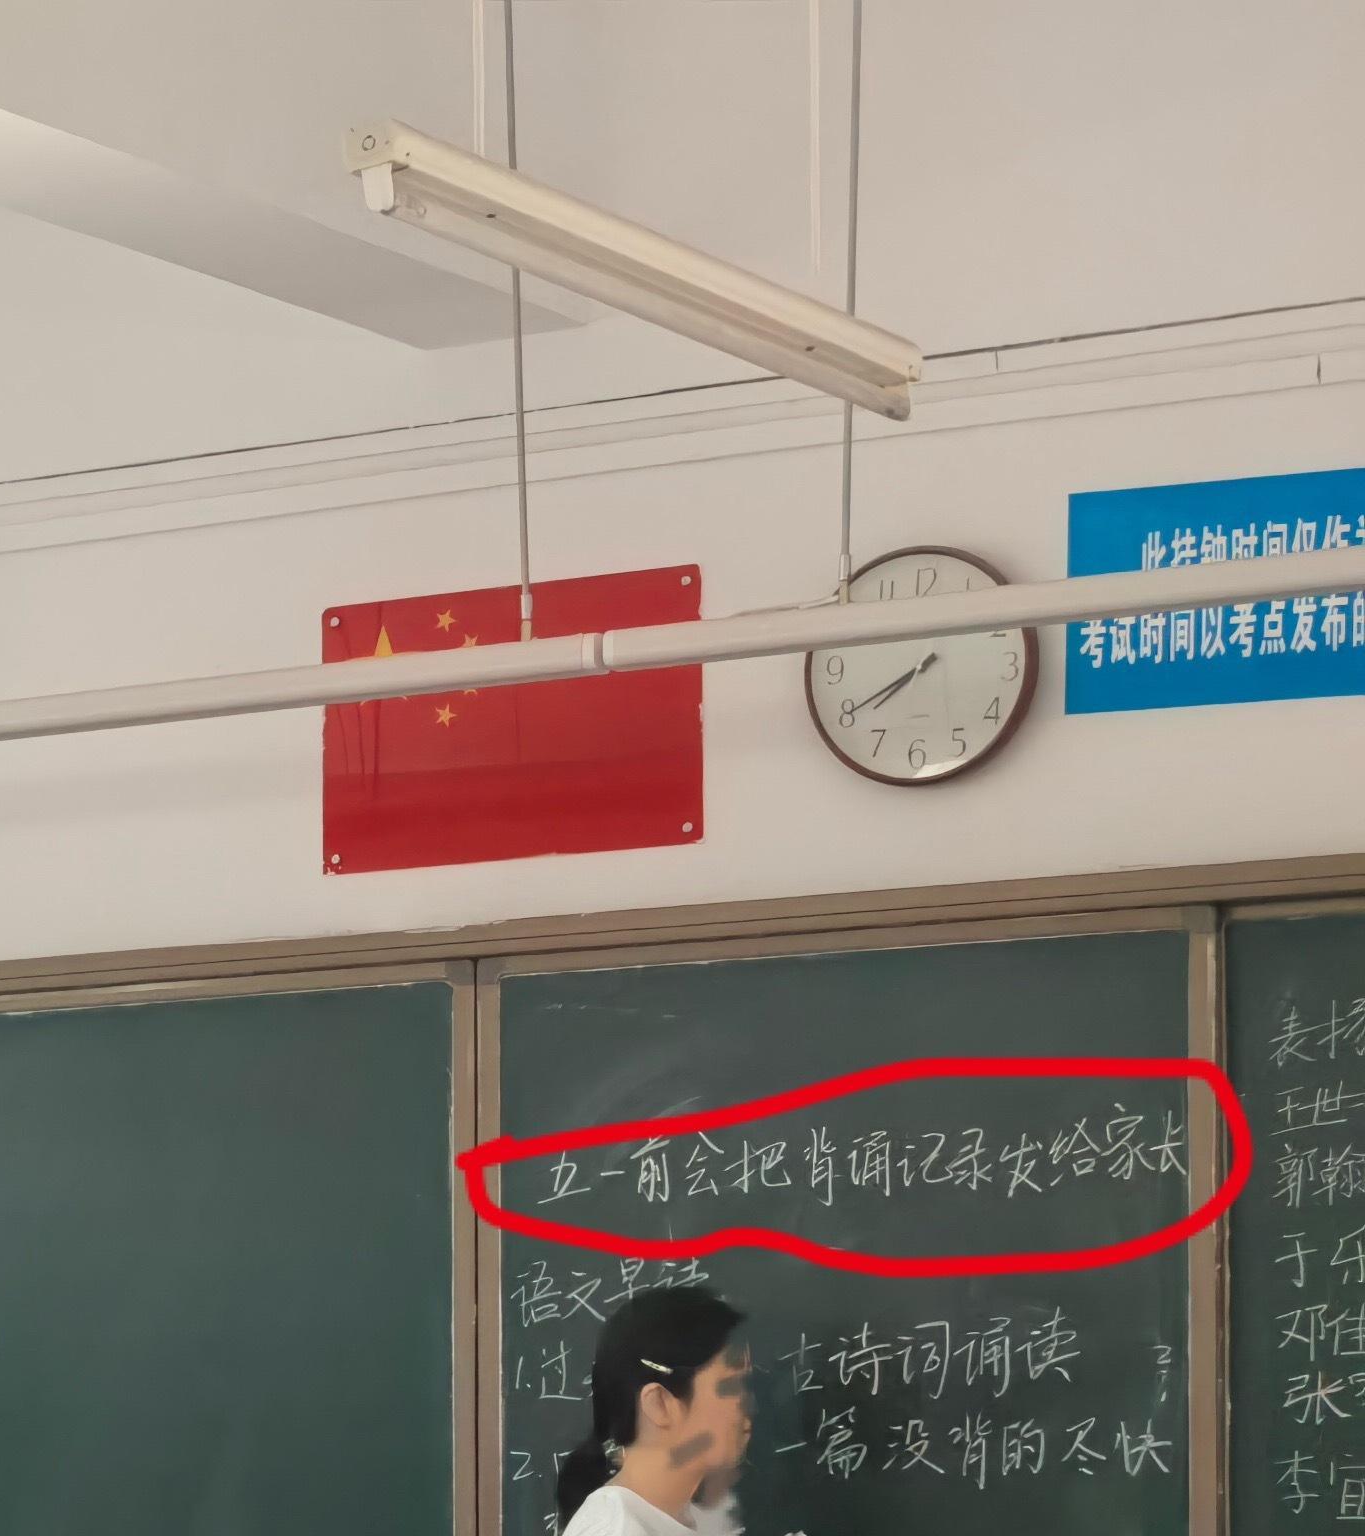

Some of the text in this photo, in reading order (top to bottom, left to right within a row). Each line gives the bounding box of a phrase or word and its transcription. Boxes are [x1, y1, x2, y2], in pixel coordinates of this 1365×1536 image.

[826, 655, 844, 685] 9
[1000, 651, 1020, 682] 3
[839, 699, 856, 728] 8
[983, 697, 1000, 726] 4
[871, 729, 887, 758] 7
[908, 738, 927, 770] 6
[951, 728, 967, 757] 5
[1269, 1080, 1365, 1136] 王世
[537, 1103, 1188, 1206] 五一前会把背诵记录发给家长
[777, 1306, 1081, 1399] 古诗词诵读
[775, 1405, 1173, 1490] 一篇没背的尽快
